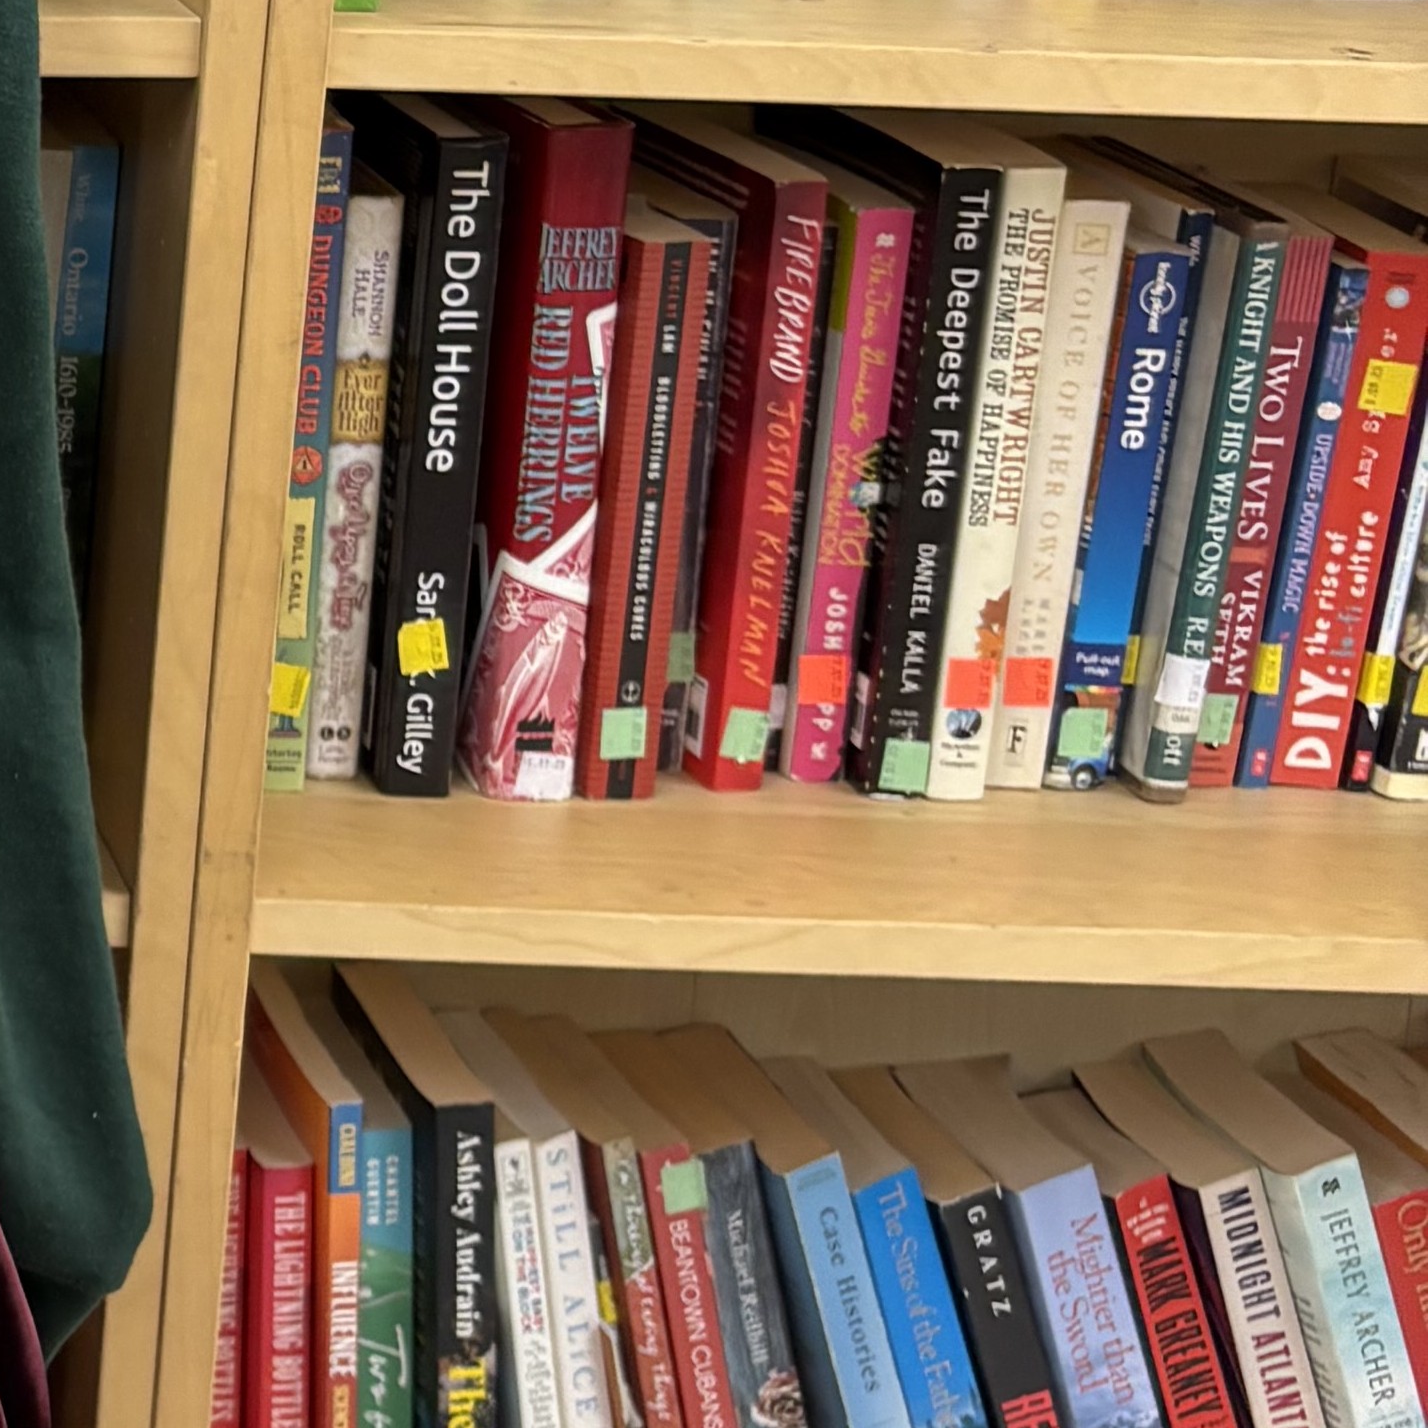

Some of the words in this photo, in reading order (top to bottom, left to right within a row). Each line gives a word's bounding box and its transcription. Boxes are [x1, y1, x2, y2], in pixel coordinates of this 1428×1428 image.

[448, 160, 491, 240] The
[954, 189, 990, 251] The
[303, 236, 334, 357] DUNGEON
[351, 269, 368, 318] HALE
[369, 250, 390, 337] SHANNON
[438, 250, 480, 333] Doll
[770, 215, 821, 383] FIREBRAND
[1019, 209, 1055, 315] JUSTIN
[1239, 257, 1274, 352] KNIGHT
[934, 269, 981, 410] Deepest
[1228, 356, 1258, 415] AND
[297, 365, 323, 435] CLUB
[426, 345, 473, 472] House
[993, 328, 1046, 525] CARTWRIGHT
[1120, 347, 1167, 450] Rome
[1217, 420, 1247, 466] HIS
[760, 401, 797, 513] JOSHUA
[921, 429, 961, 509] Fake
[909, 542, 937, 620] DANIEL
[1193, 471, 1235, 597] WEAPONS
[738, 530, 783, 688] KNELMAN
[1211, 592, 1235, 665] SETH
[1225, 571, 1262, 685] VIKRAM
[900, 630, 928, 694] KALLA
[397, 693, 434, 774] Gilley
[817, 1207, 844, 1267] Case
[836, 1274, 882, 1394] Histories
[967, 1206, 1011, 1318] GRATZ
[1217, 1185, 1281, 1326] MIDNIGHT
[1320, 1208, 1370, 1313] JEFFREY
[1352, 1311, 1395, 1406] ARCHER
